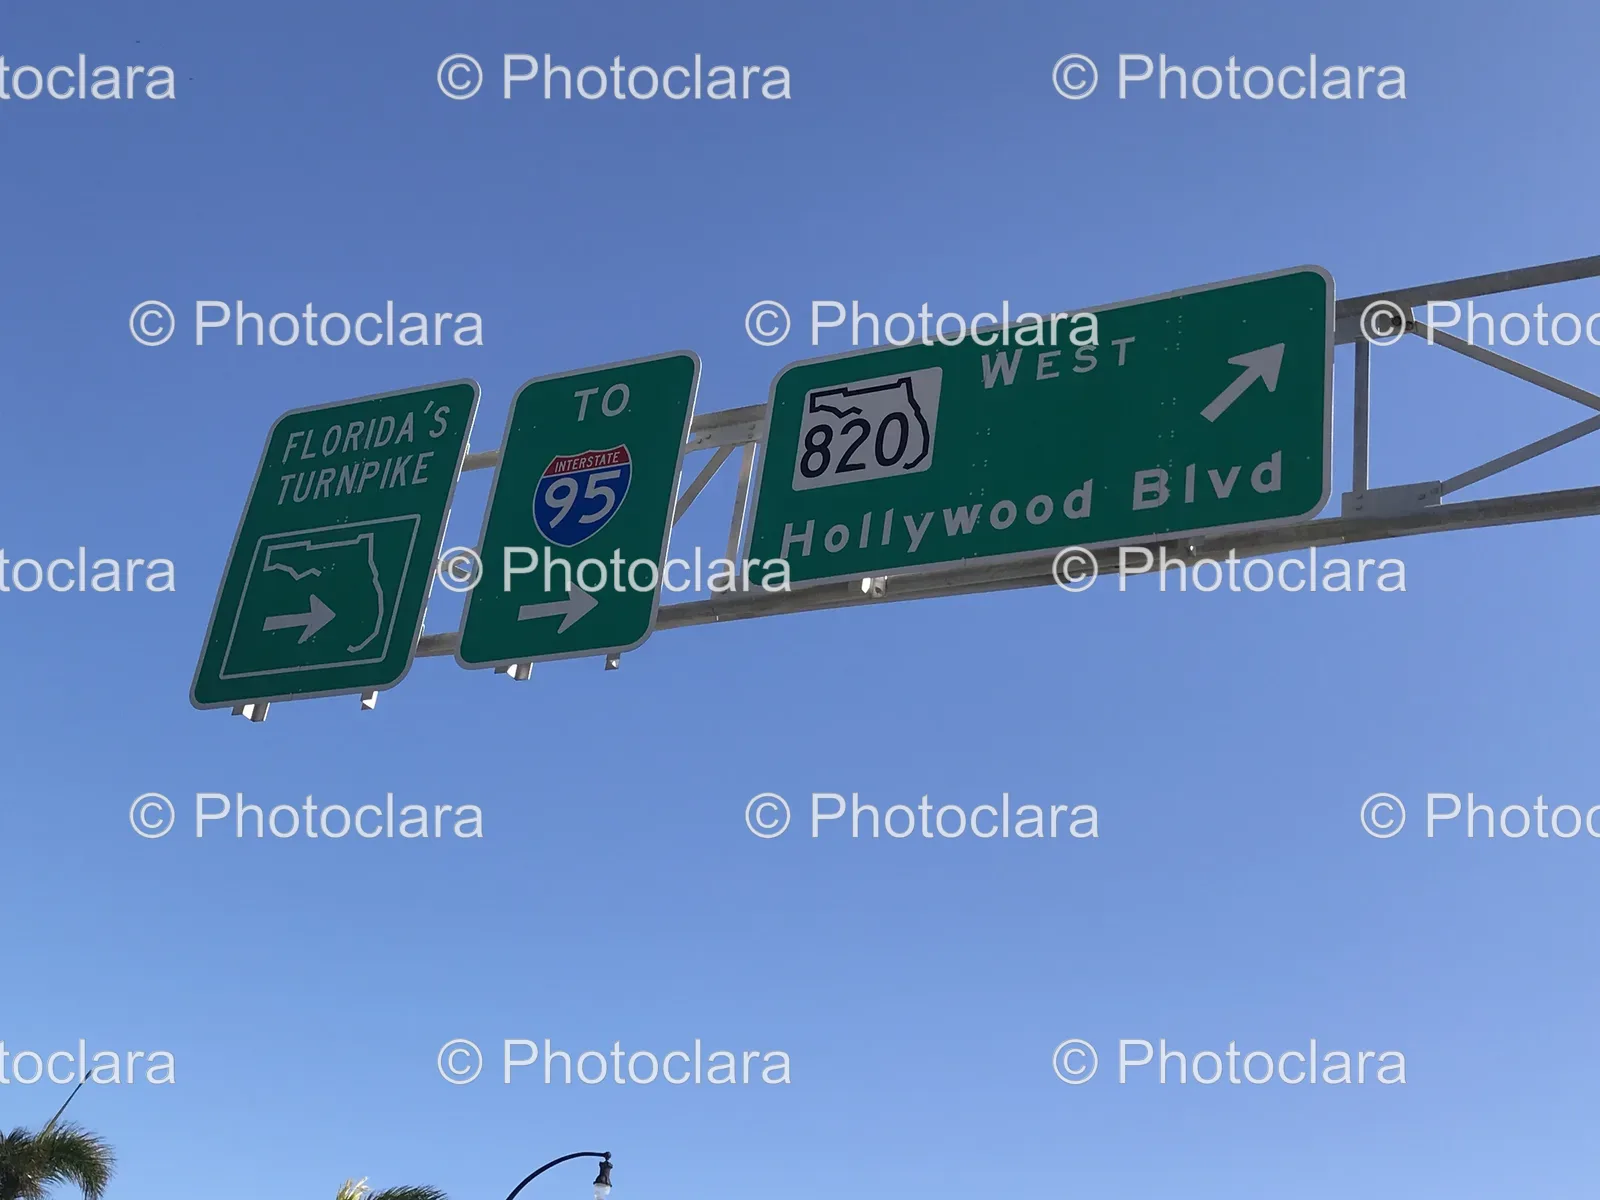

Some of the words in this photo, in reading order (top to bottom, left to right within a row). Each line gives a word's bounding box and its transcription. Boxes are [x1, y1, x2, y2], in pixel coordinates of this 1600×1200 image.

[981, 336, 1136, 389] WEST
[573, 383, 631, 422] TO
[282, 400, 451, 463] FLORIDA'S
[800, 412, 908, 479] 820
[277, 451, 435, 506] TURNPIKE
[554, 451, 621, 473] INTERSTATE
[544, 469, 621, 529] 95
[779, 479, 1094, 560] Hollywood
[1132, 450, 1284, 512] Blvd
